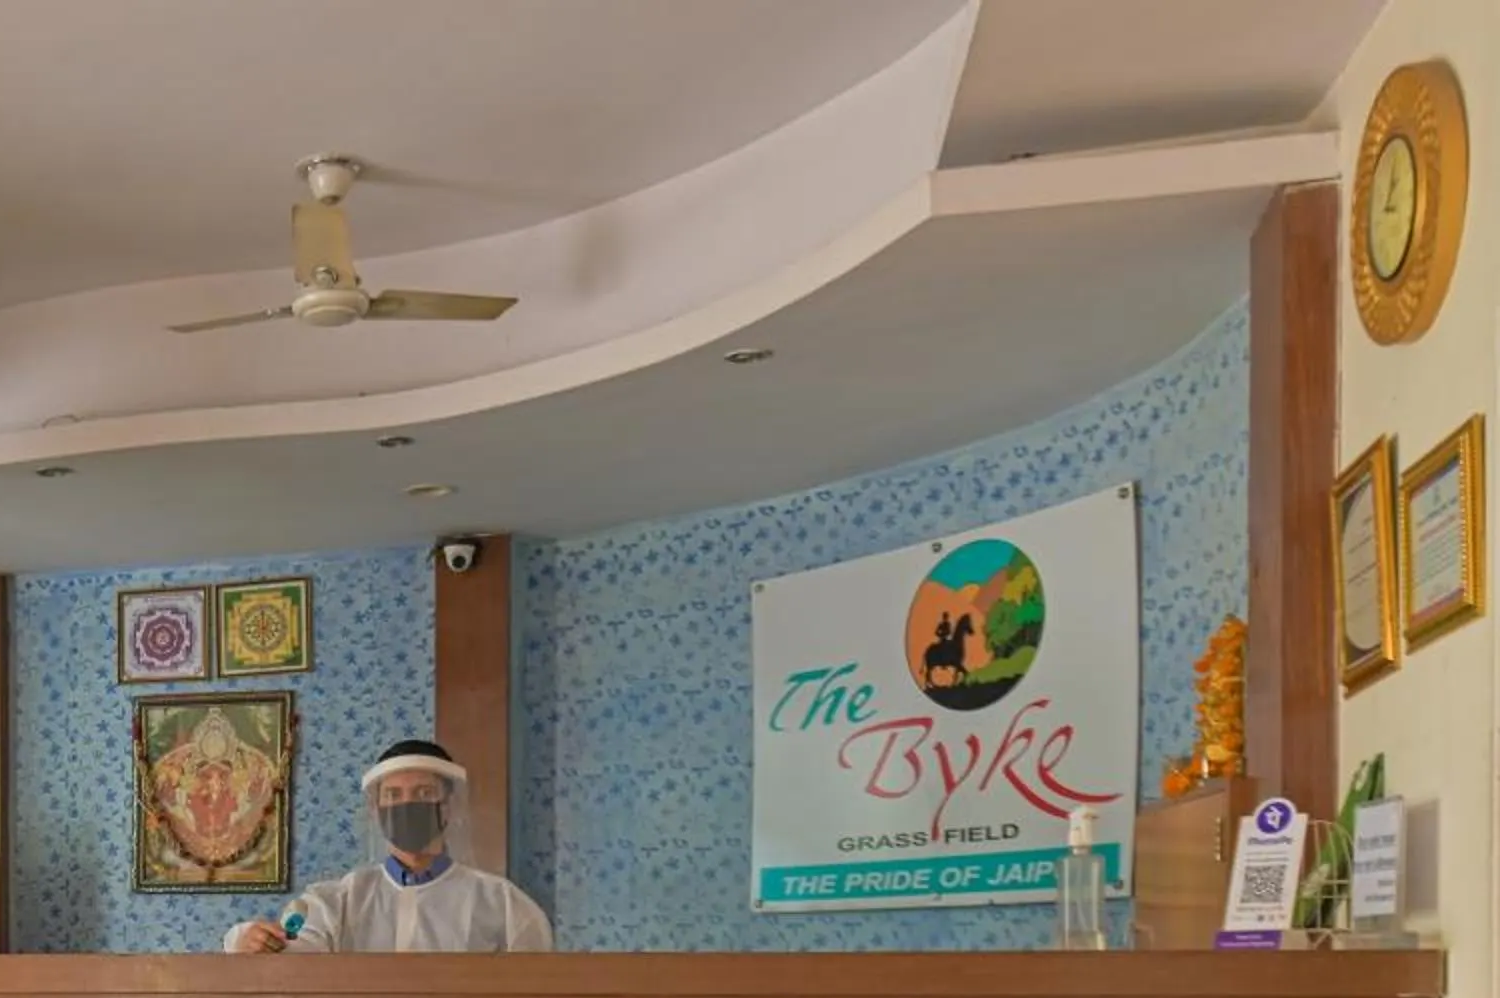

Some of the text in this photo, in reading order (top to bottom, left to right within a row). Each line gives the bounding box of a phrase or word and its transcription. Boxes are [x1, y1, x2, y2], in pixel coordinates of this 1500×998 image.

[769, 662, 881, 732] The
[838, 699, 1124, 841] Byke
[838, 822, 1021, 853] GRASS FIELD
[783, 860, 1062, 896] THE PRIDE OF JAIP
